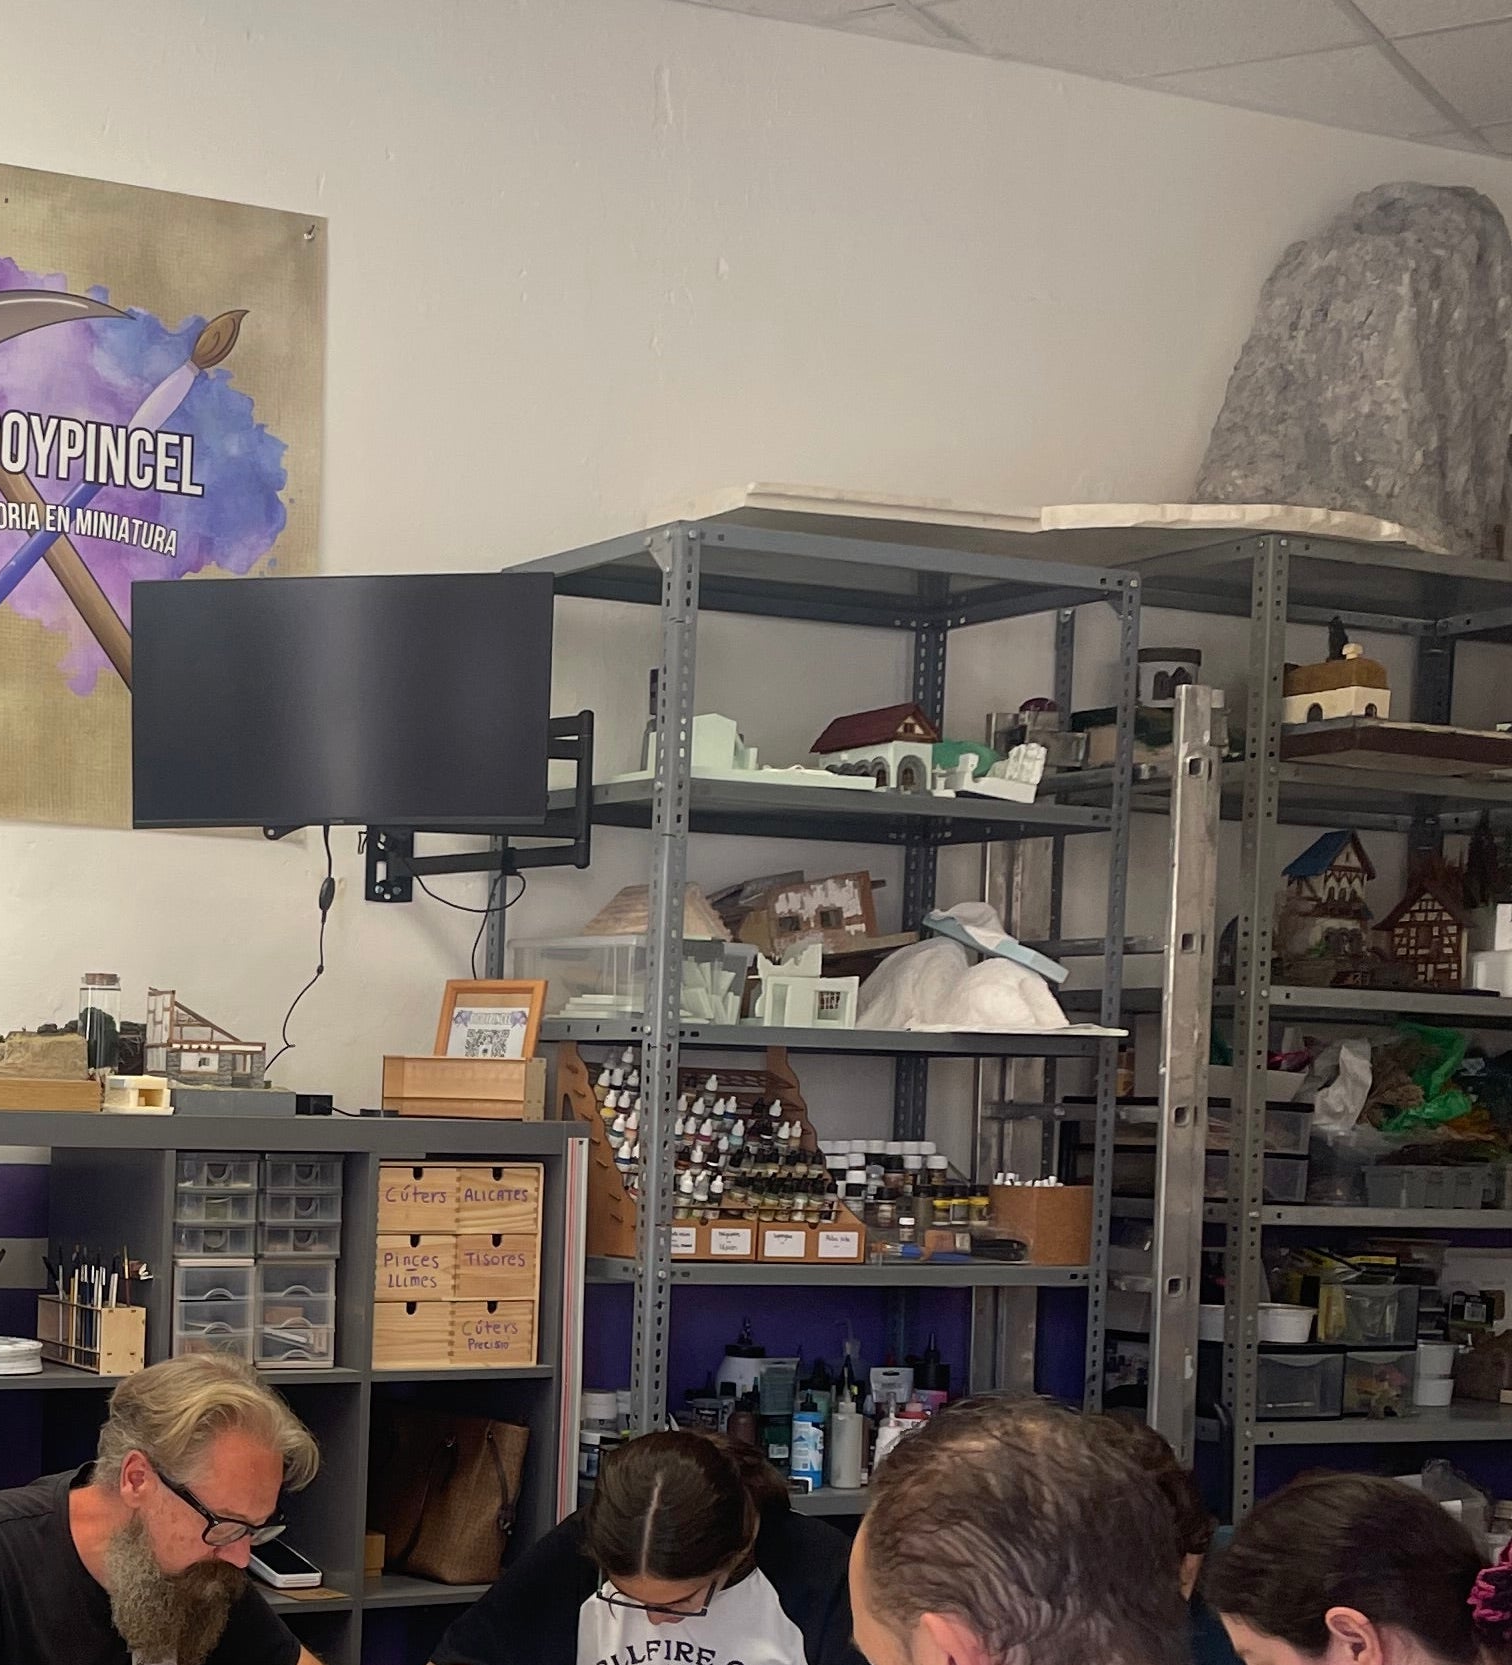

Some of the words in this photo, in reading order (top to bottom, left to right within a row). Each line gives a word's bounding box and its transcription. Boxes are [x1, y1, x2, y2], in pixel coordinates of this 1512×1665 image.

[45, 505, 71, 533] EN
[75, 508, 178, 557] MINIATURA
[385, 1185, 447, 1203] Cúters
[384, 1252, 439, 1269] Pinces
[462, 1320, 518, 1336] Cúters
